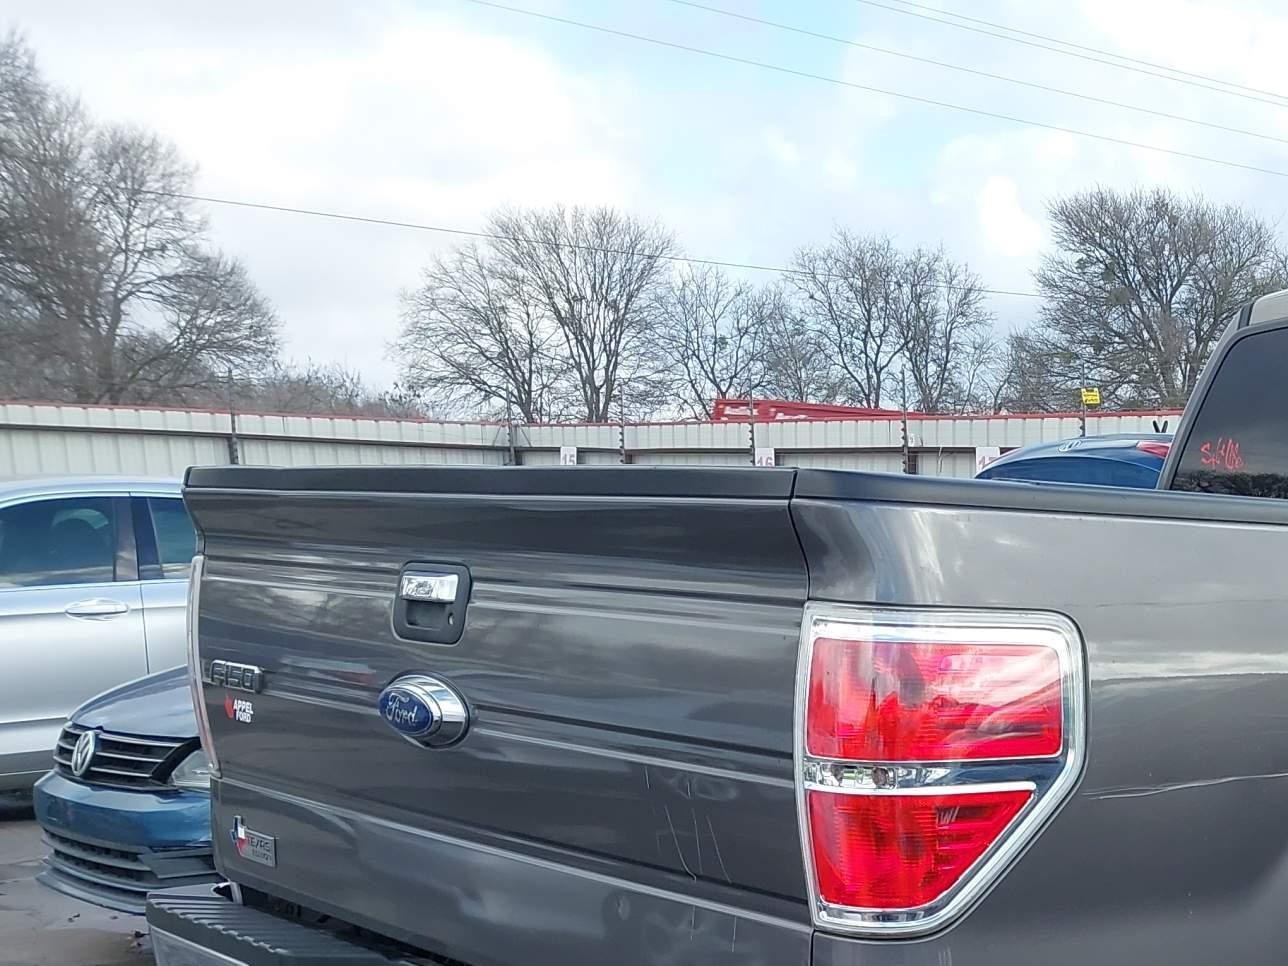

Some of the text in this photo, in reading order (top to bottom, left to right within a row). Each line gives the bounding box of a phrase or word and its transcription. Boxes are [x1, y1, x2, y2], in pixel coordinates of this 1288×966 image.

[233, 698, 254, 715] APPEL
[385, 692, 419, 726] Ford
[236, 711, 252, 724] FORD
